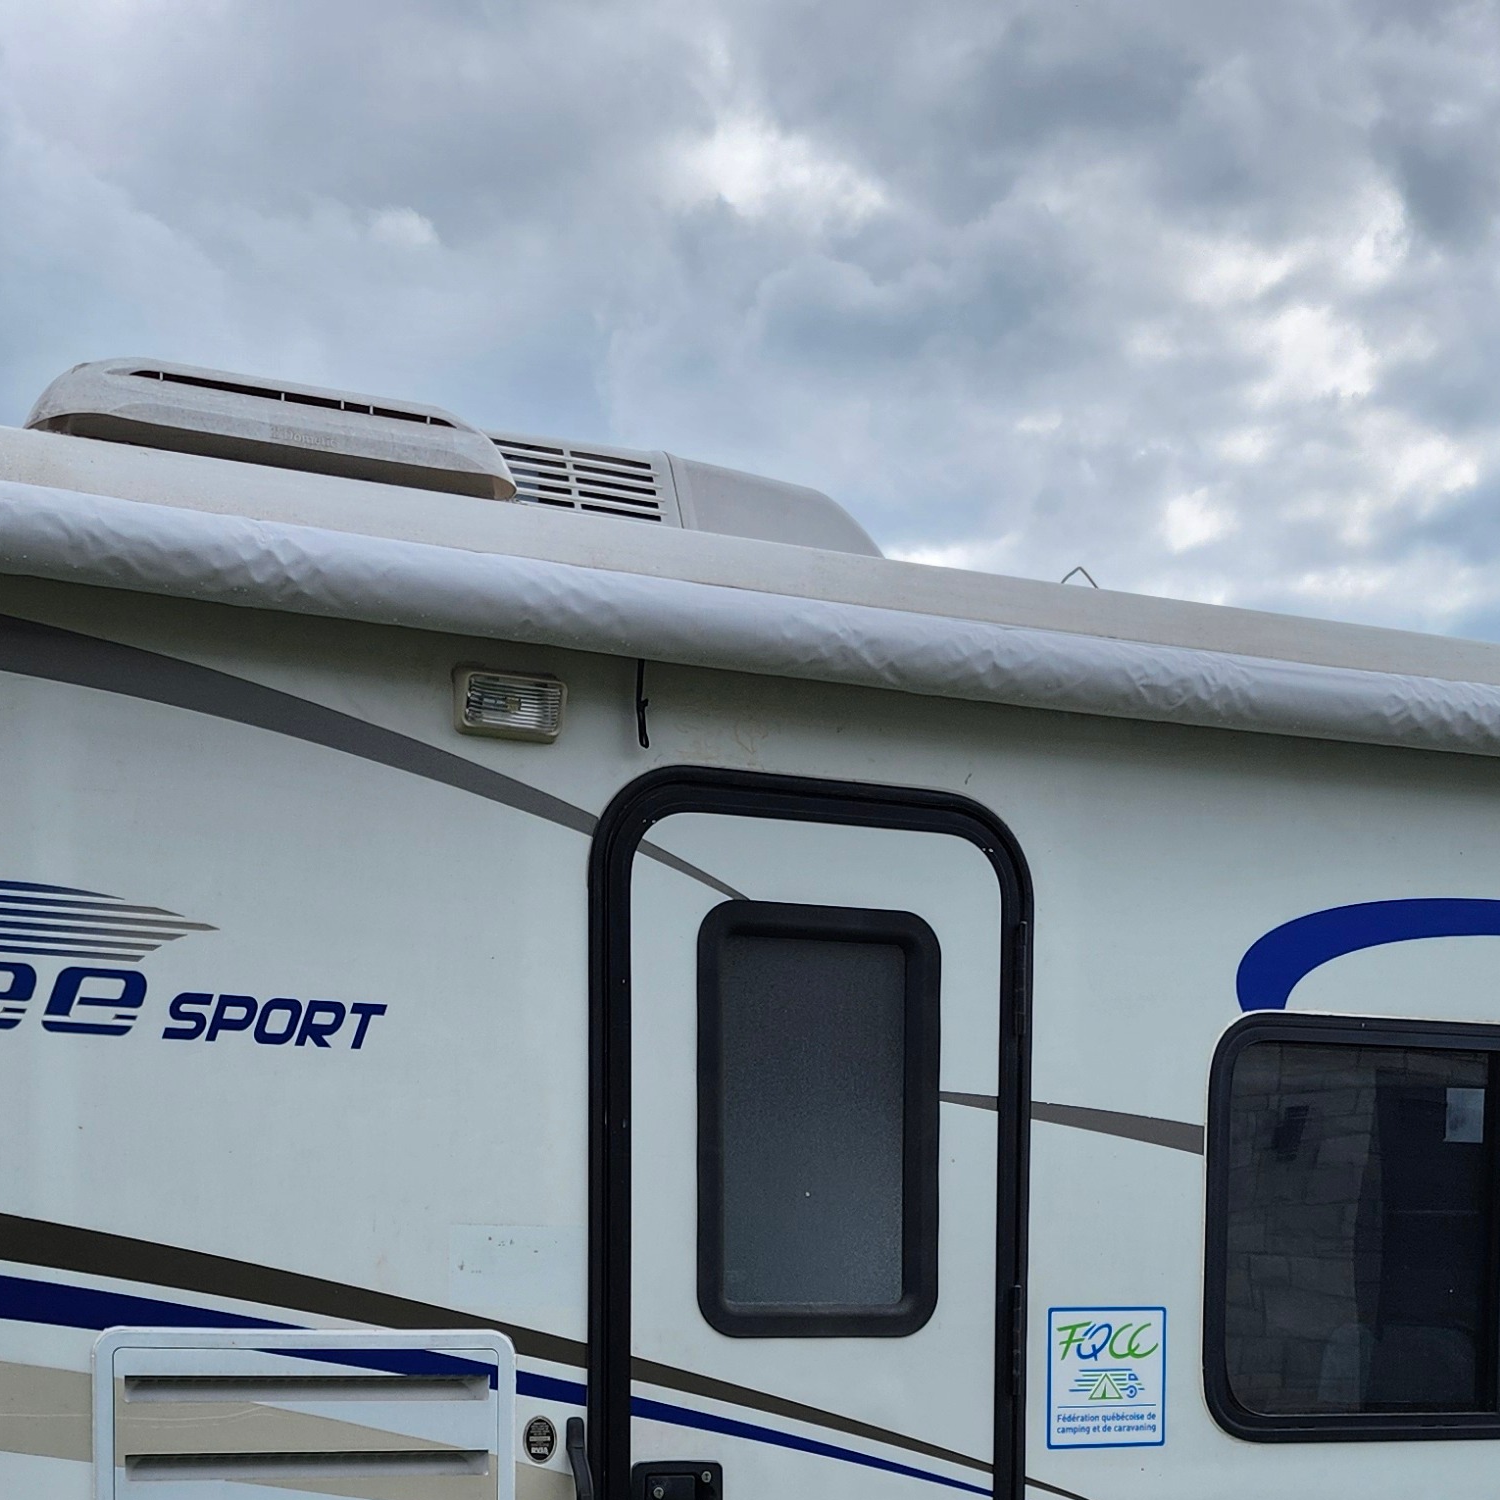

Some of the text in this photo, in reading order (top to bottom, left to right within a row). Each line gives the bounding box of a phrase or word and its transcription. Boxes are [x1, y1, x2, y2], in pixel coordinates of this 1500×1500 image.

[161, 991, 389, 1050] SPORT
[1056, 1320, 1159, 1361] FQCC
[1056, 1411, 1157, 1424] Fédération québécoise de
[1056, 1422, 1157, 1435] camping et de caravaning
